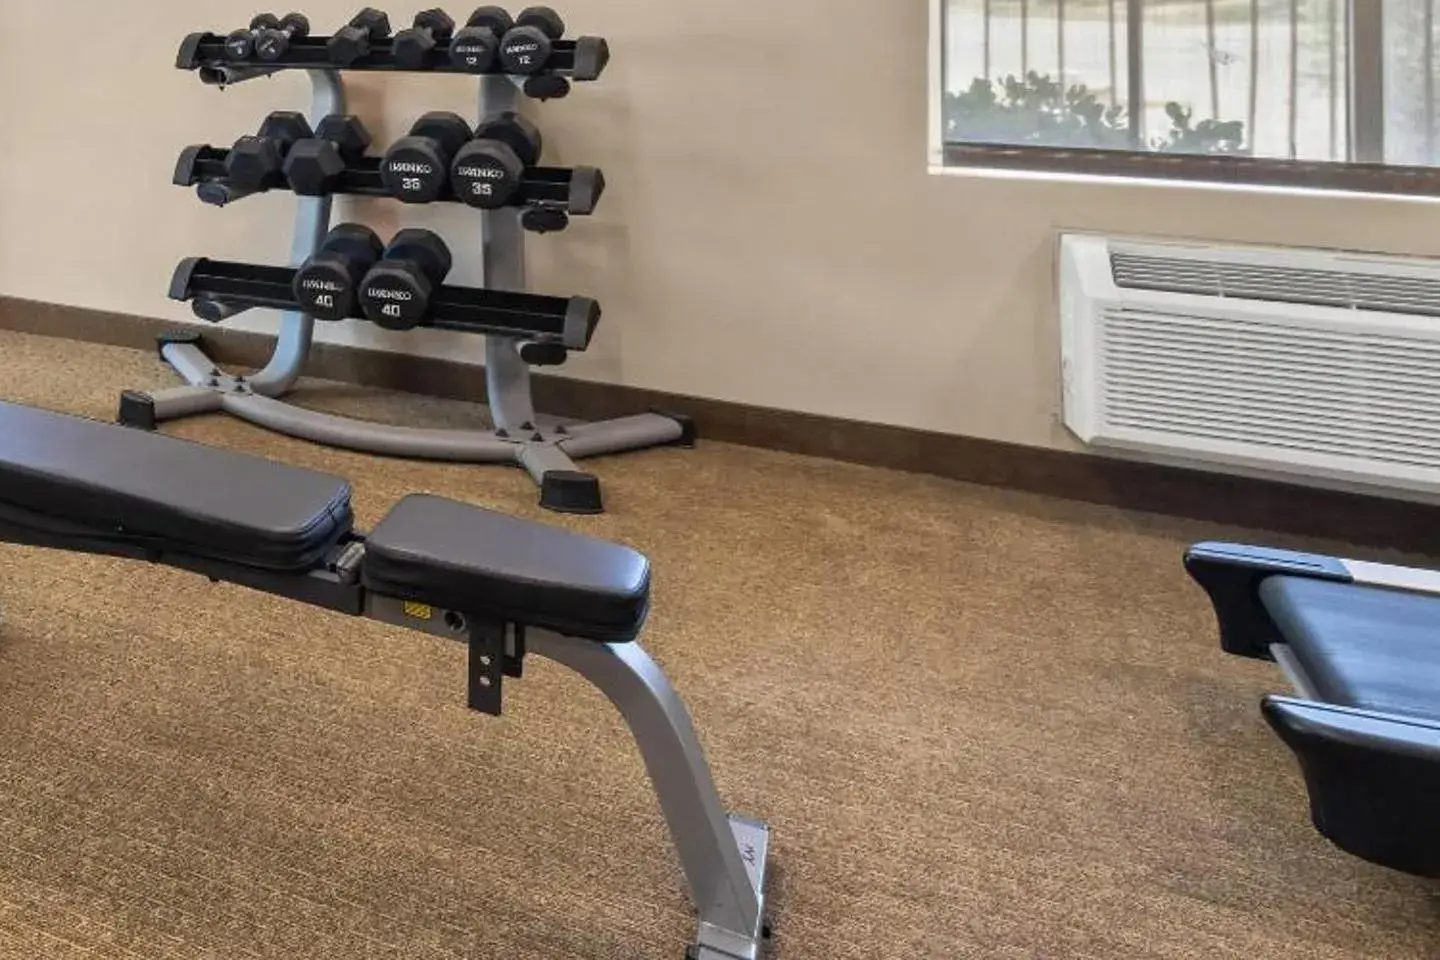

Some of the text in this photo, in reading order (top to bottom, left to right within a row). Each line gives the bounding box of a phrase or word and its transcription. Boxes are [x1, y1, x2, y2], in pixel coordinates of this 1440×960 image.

[471, 181, 493, 195] 35
[315, 295, 334, 308] 40
[381, 304, 401, 317] 40
